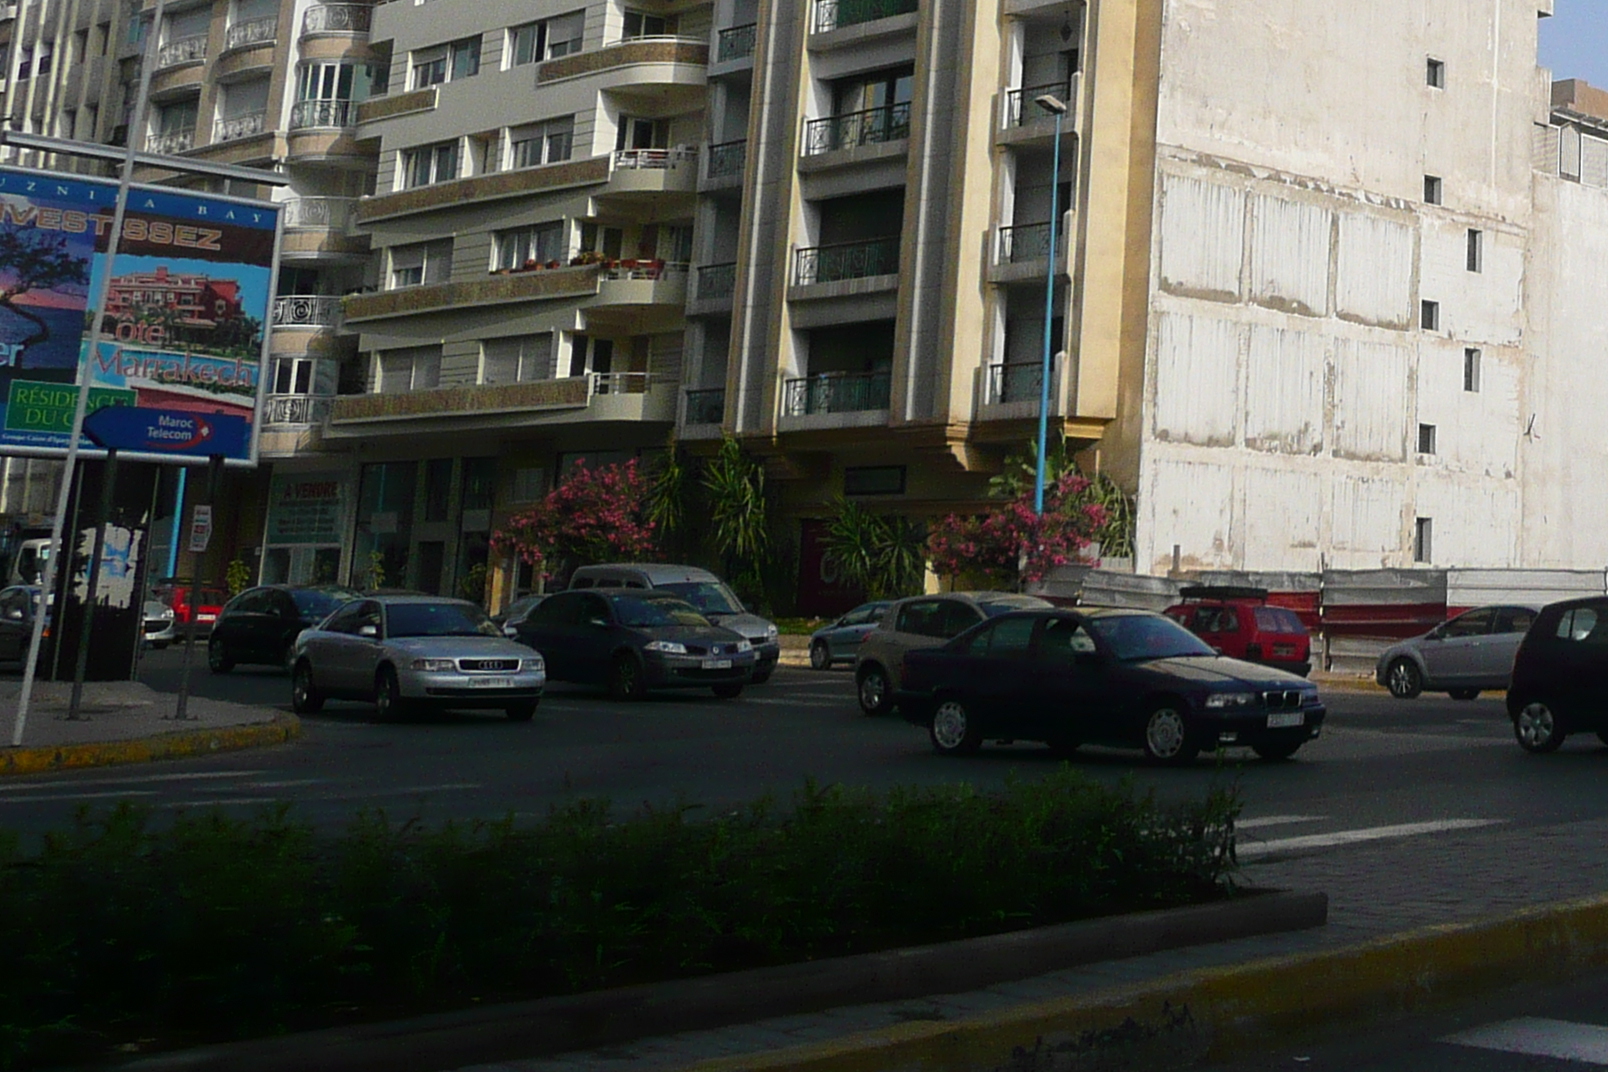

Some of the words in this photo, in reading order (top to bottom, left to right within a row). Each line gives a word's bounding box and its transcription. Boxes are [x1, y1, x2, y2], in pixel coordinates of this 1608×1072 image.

[198, 205, 261, 223] BAY
[0, 203, 222, 251] VESTSSEZ
[94, 346, 254, 387] Marrakech
[25, 408, 57, 426] DU
[158, 415, 194, 428] Maroc
[147, 426, 192, 441] Telecom
